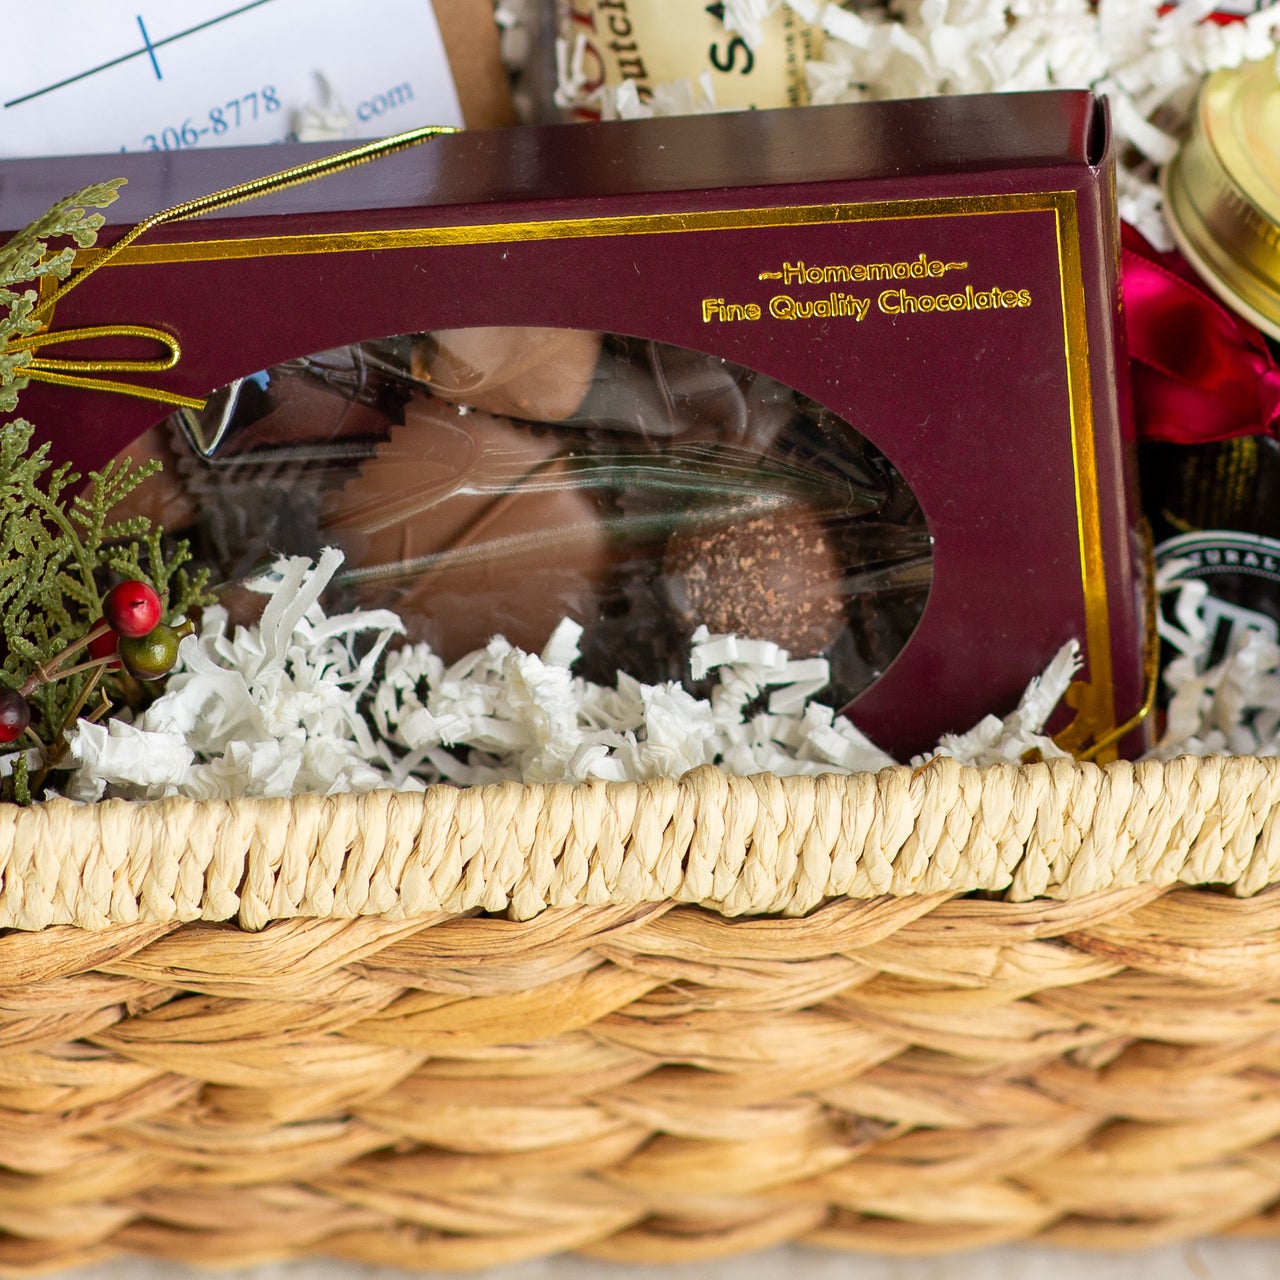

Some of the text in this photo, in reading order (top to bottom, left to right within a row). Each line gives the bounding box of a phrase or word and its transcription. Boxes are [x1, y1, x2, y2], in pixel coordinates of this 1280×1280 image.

[701, 285, 1033, 322] Fine Quality Chocolates
